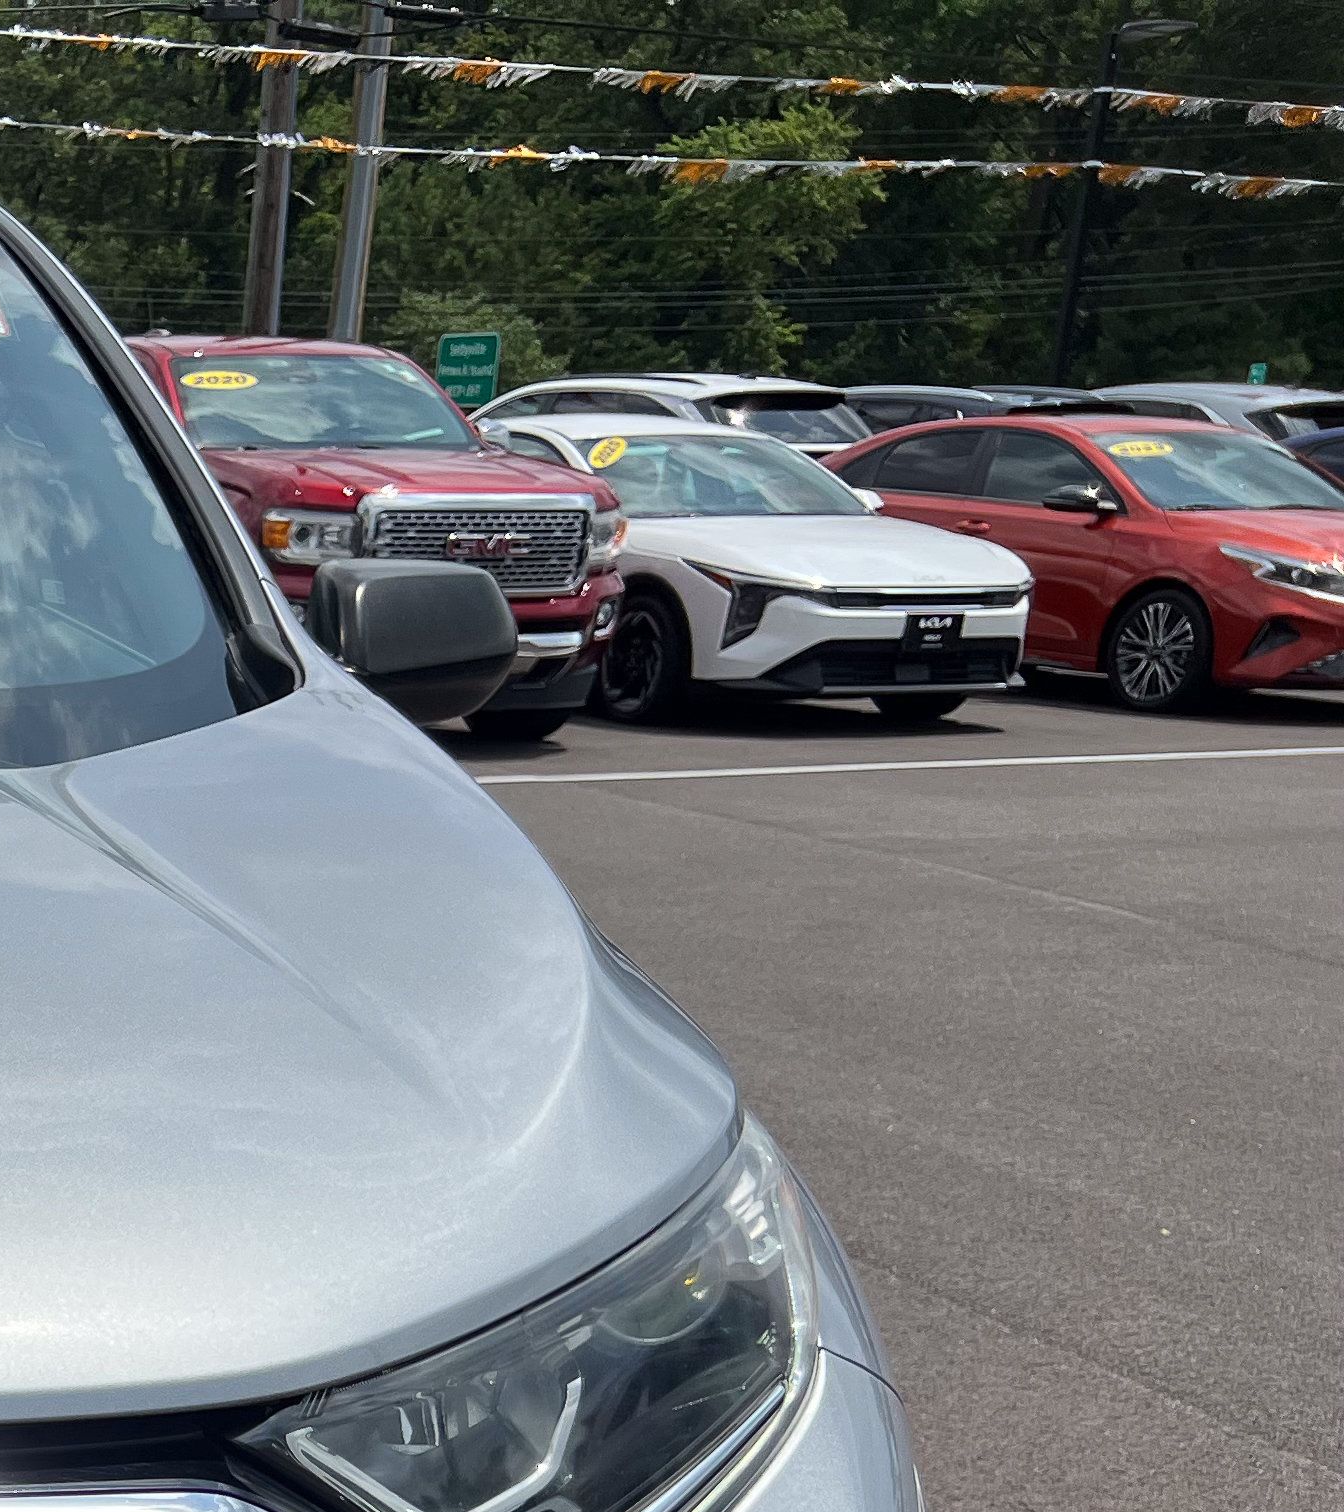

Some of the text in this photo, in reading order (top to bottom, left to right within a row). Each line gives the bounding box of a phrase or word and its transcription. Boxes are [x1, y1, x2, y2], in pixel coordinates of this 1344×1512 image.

[193, 375, 247, 385] 2020
[446, 532, 532, 557] GMC
[918, 617, 953, 629] KIA
